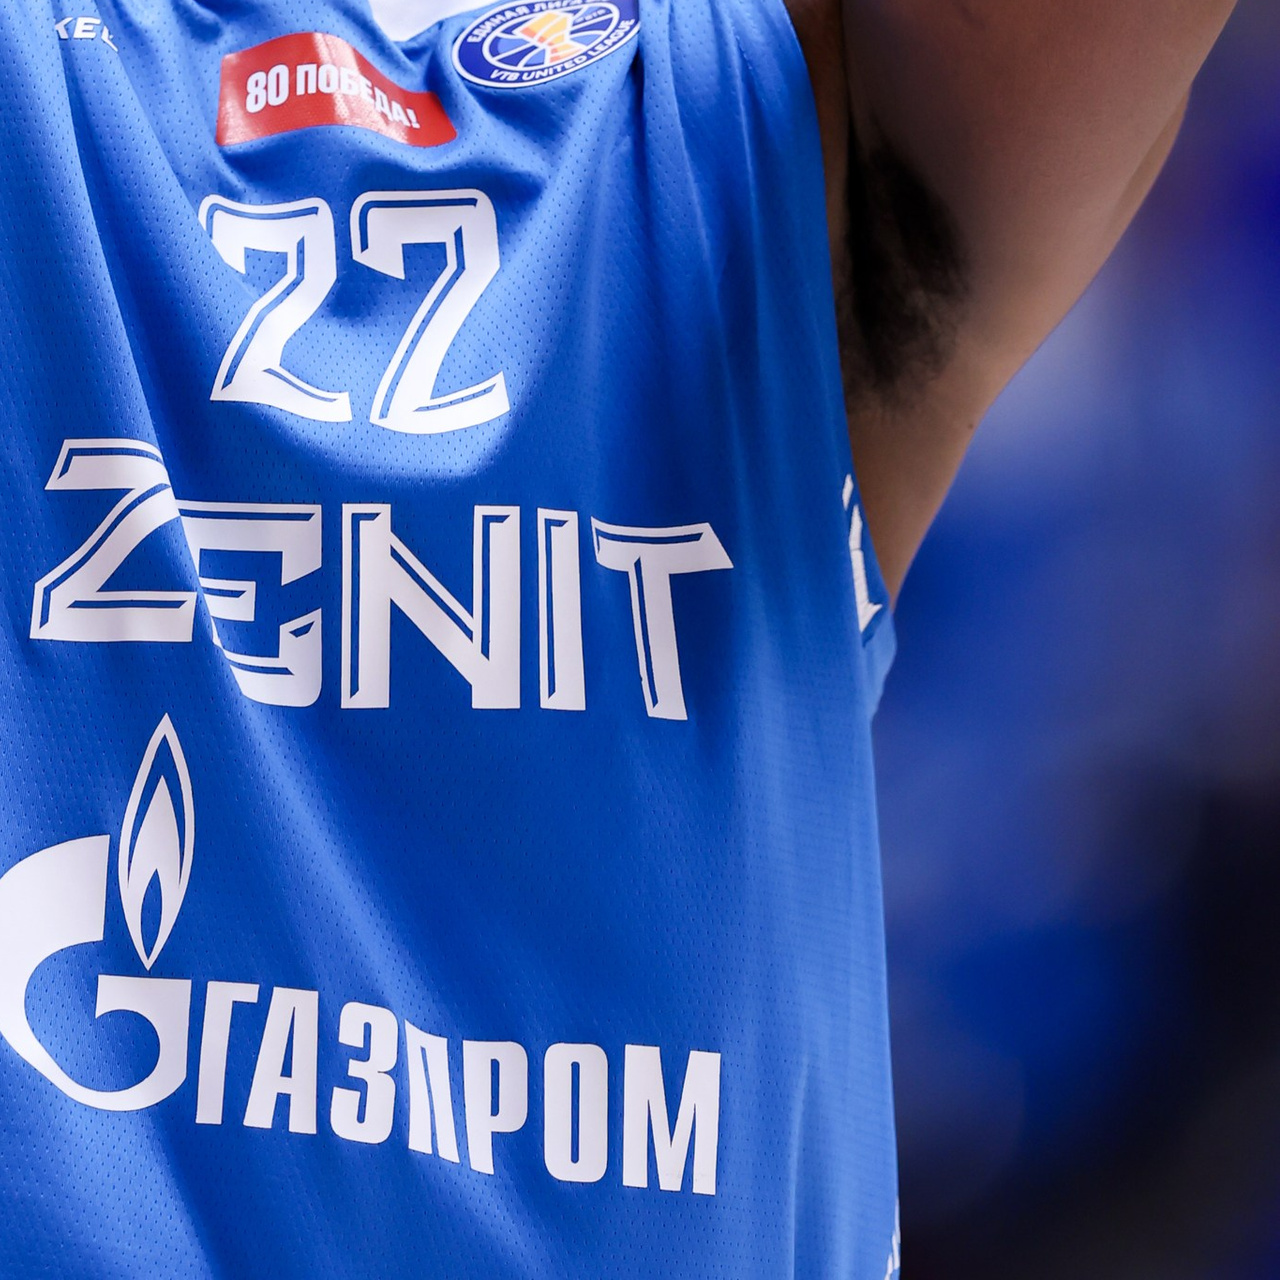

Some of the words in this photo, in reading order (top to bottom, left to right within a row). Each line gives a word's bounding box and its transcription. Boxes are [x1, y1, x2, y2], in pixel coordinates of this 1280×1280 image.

[466, 5, 530, 43] ЕДИНАЯ
[490, 69, 520, 82] VTB
[521, 54, 588, 81] UNITED
[587, 18, 636, 57] LEAGUE
[245, 63, 290, 114] 80
[296, 63, 421, 129] ПОБЕДА!
[198, 187, 510, 435] 22
[30, 437, 734, 721] ZENIT
[196, 979, 722, 1197] ГАЗПРОМ
